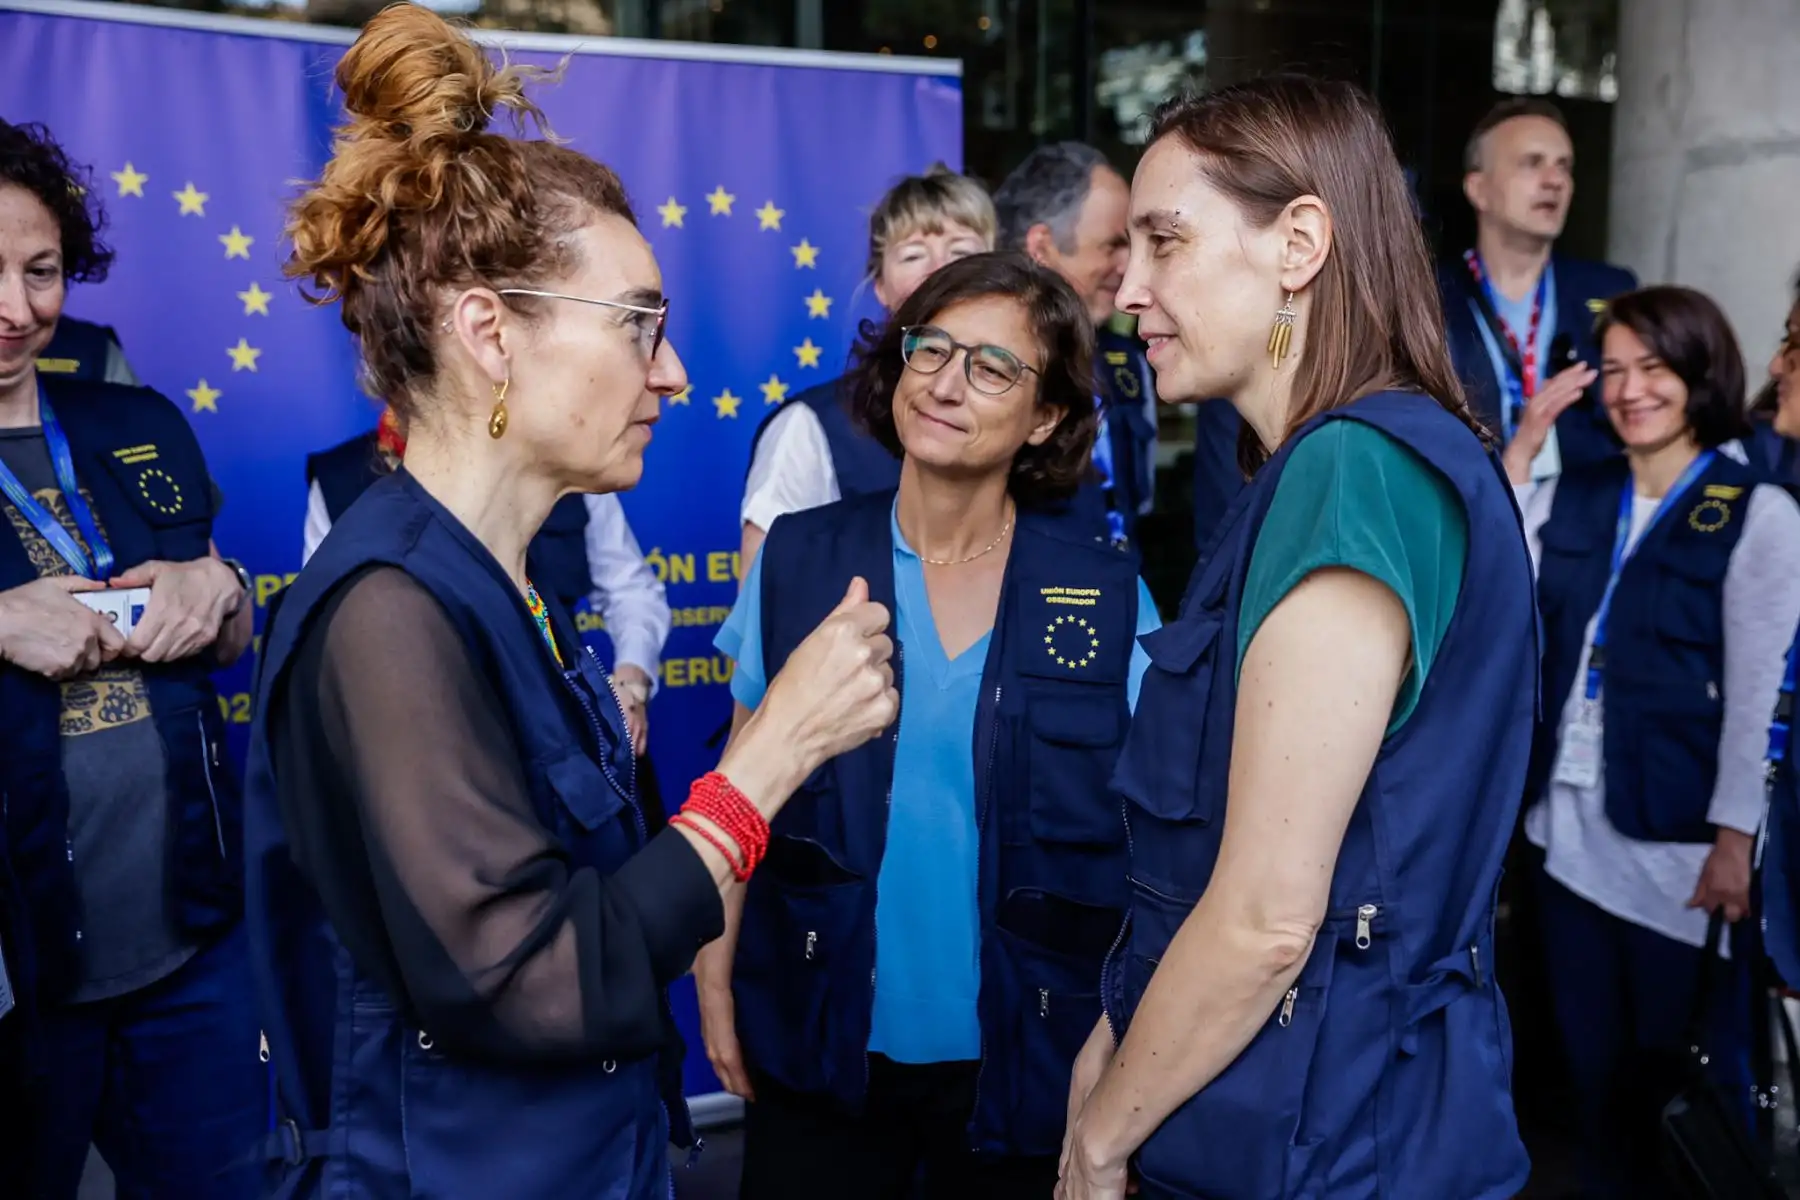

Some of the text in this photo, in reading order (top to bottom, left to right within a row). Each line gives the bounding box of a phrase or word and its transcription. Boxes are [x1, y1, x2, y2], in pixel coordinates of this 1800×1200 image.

[1040, 586, 1101, 596] UNIÓN EUROPEA
[1046, 596, 1096, 605] OBSERVADOR
